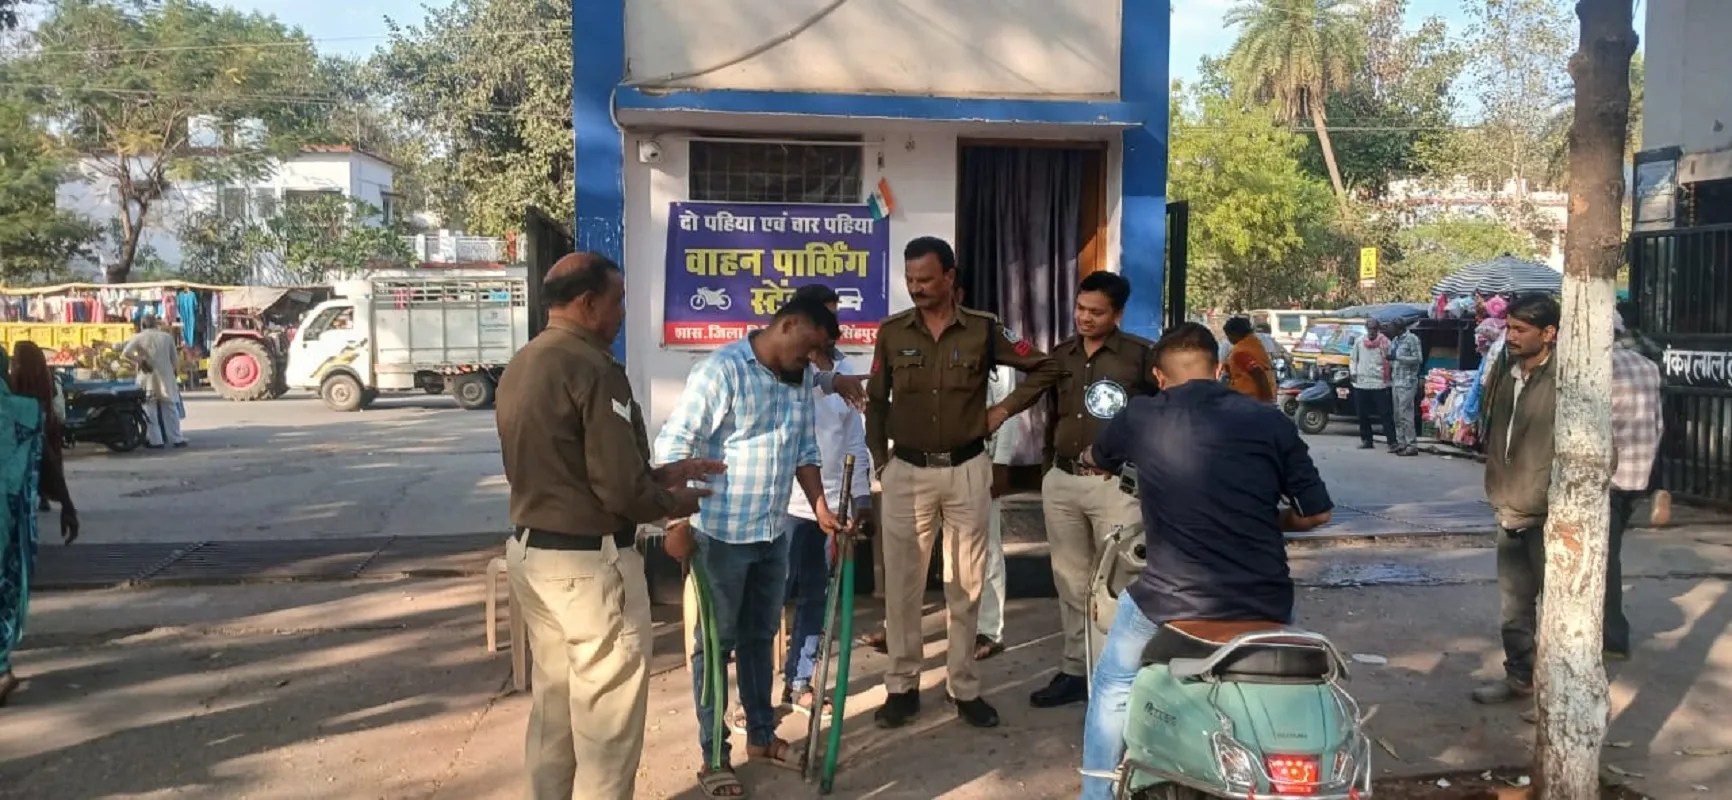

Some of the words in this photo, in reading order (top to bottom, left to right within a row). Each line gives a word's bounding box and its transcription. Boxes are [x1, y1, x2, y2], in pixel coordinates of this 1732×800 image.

[679, 210, 700, 231] दो
[704, 211, 756, 232] पहिया
[760, 211, 788, 232] एवं
[824, 213, 874, 234] पहिया
[684, 249, 765, 277] वाहन
